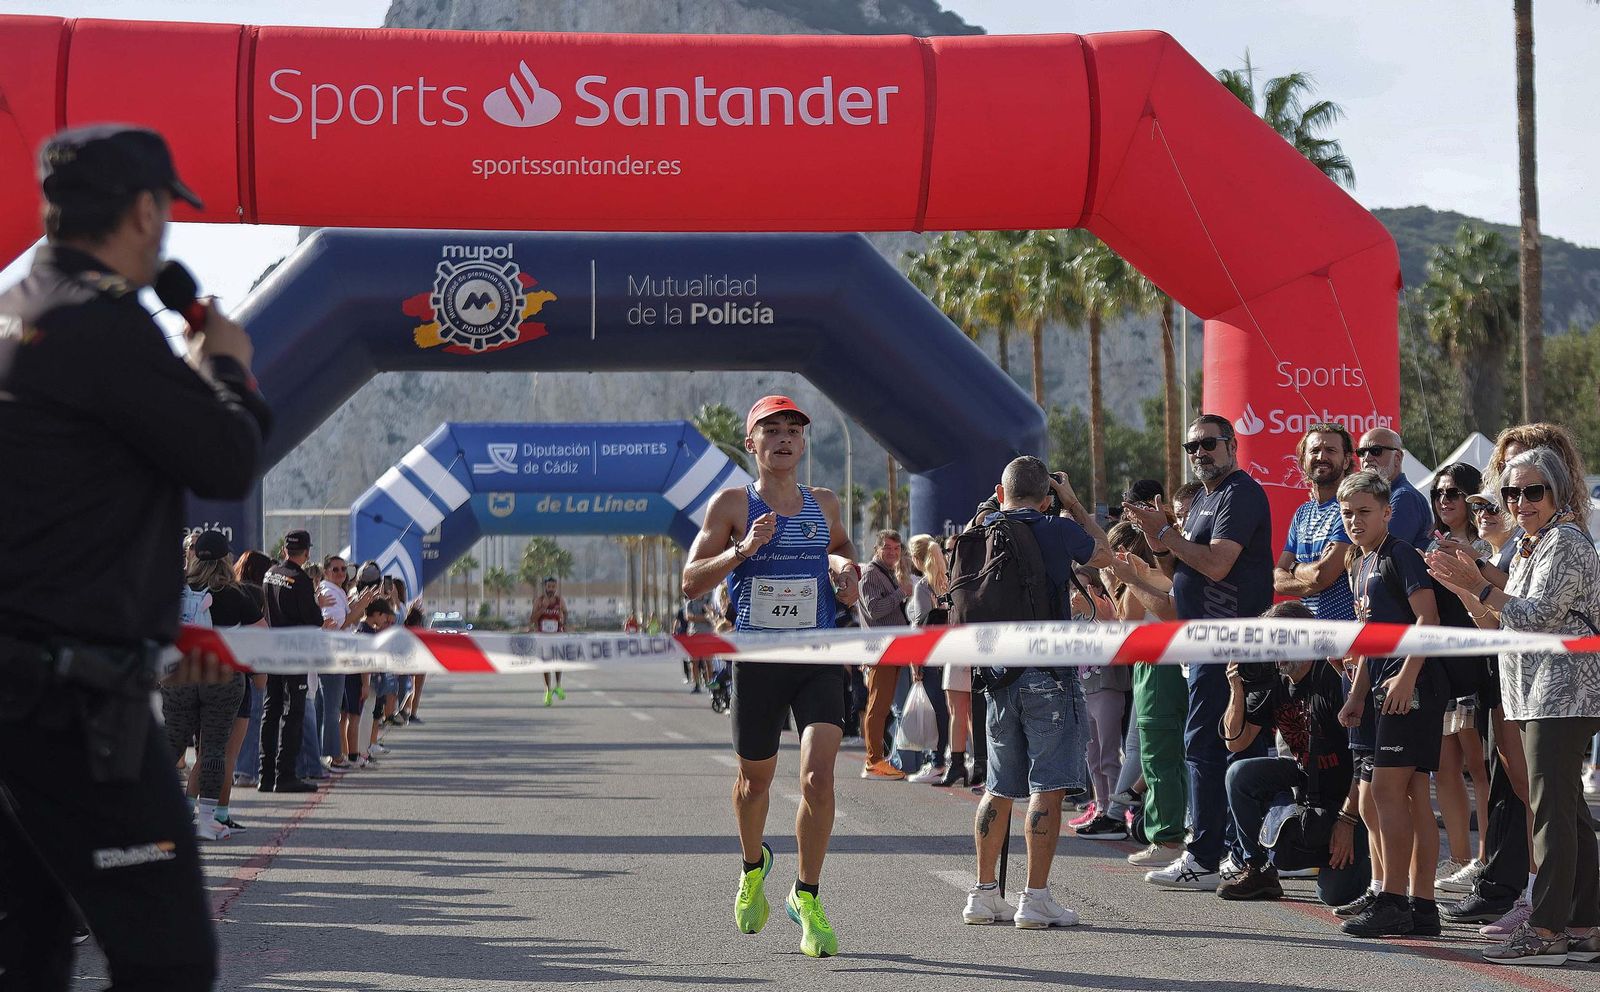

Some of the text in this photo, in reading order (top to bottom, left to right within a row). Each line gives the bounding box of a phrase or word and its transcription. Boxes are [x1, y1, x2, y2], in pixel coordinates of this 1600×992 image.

[268, 68, 899, 140] Sports Santander
[472, 156, 681, 180] sportssantander.es
[442, 243, 514, 262] mupol
[628, 273, 757, 297] Mutualidad
[628, 301, 774, 325] de la Policía
[462, 324, 496, 334] POLICÍA
[1276, 361, 1364, 394] Sports
[1269, 409, 1393, 434] Santander
[523, 442, 667, 459] Diputación DEPORTES
[524, 460, 578, 474] de Cádiz
[536, 494, 648, 513] de La Línea
[767, 552, 799, 561] Atletismo
[772, 605, 798, 617] 474
[1186, 625, 1311, 645] LINEA DE POLICIA
[541, 637, 676, 661] LINEA DE POLICIA
